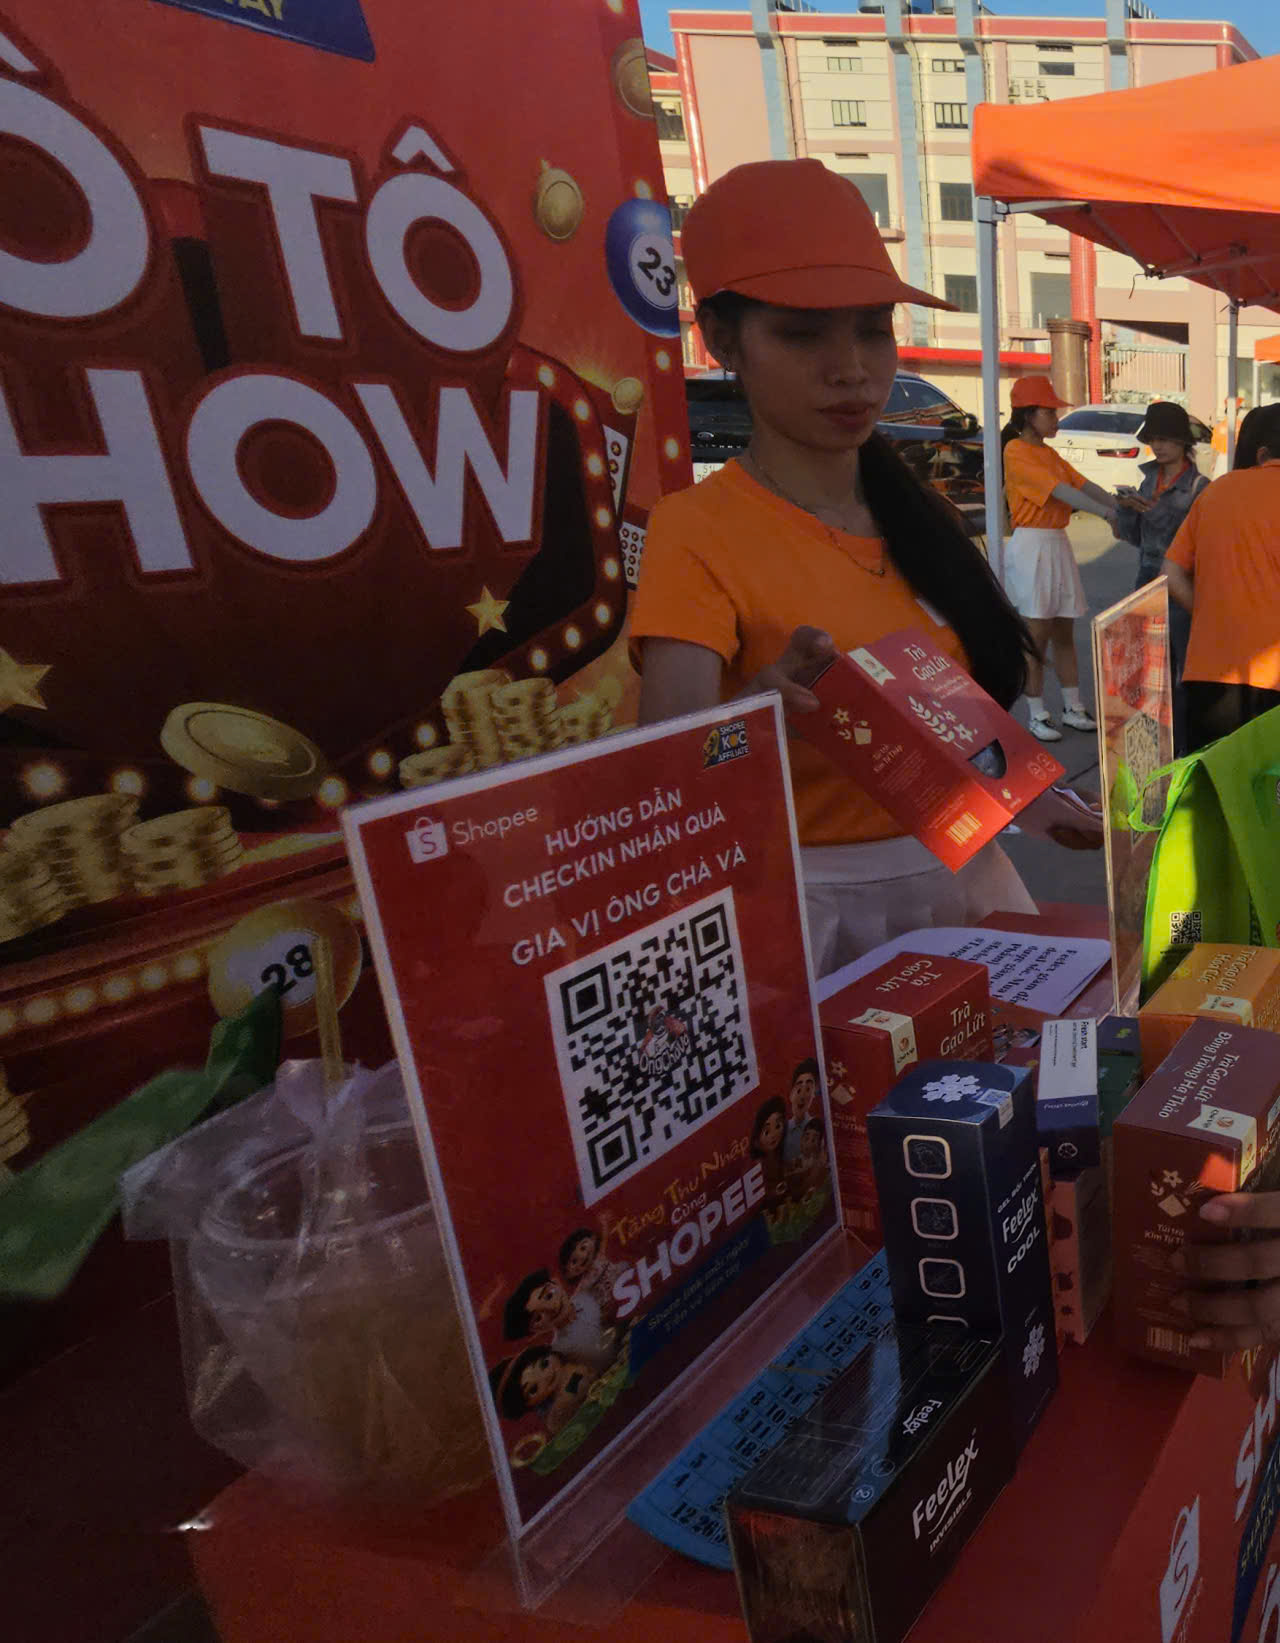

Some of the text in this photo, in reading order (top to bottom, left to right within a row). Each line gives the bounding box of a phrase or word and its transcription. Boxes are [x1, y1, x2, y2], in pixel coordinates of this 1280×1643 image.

[0, 27, 513, 352] Ô TÔ
[637, 246, 676, 297] 23
[0, 368, 539, 586] HOW
[453, 806, 539, 845] Shopee
[544, 805, 633, 856] HƯỚNG
[503, 800, 727, 908] CHECKIN NHẬN QUÀ
[511, 840, 747, 966] GIA VỊ ÔNG CHÀ VÀ
[260, 944, 313, 993] 28
[909, 972, 942, 987] Trà
[951, 1000, 971, 1027] Trà
[1184, 1052, 1217, 1080] Trùng
[1202, 1031, 1233, 1055] Đông
[1224, 1052, 1241, 1069] Trà
[612, 1159, 768, 1318] SHOPEE
[1002, 1187, 1039, 1244] Feelex
[1007, 1225, 1040, 1274] COOL
[902, 1399, 943, 1435] Feelex
[912, 1437, 980, 1540] Feelex
